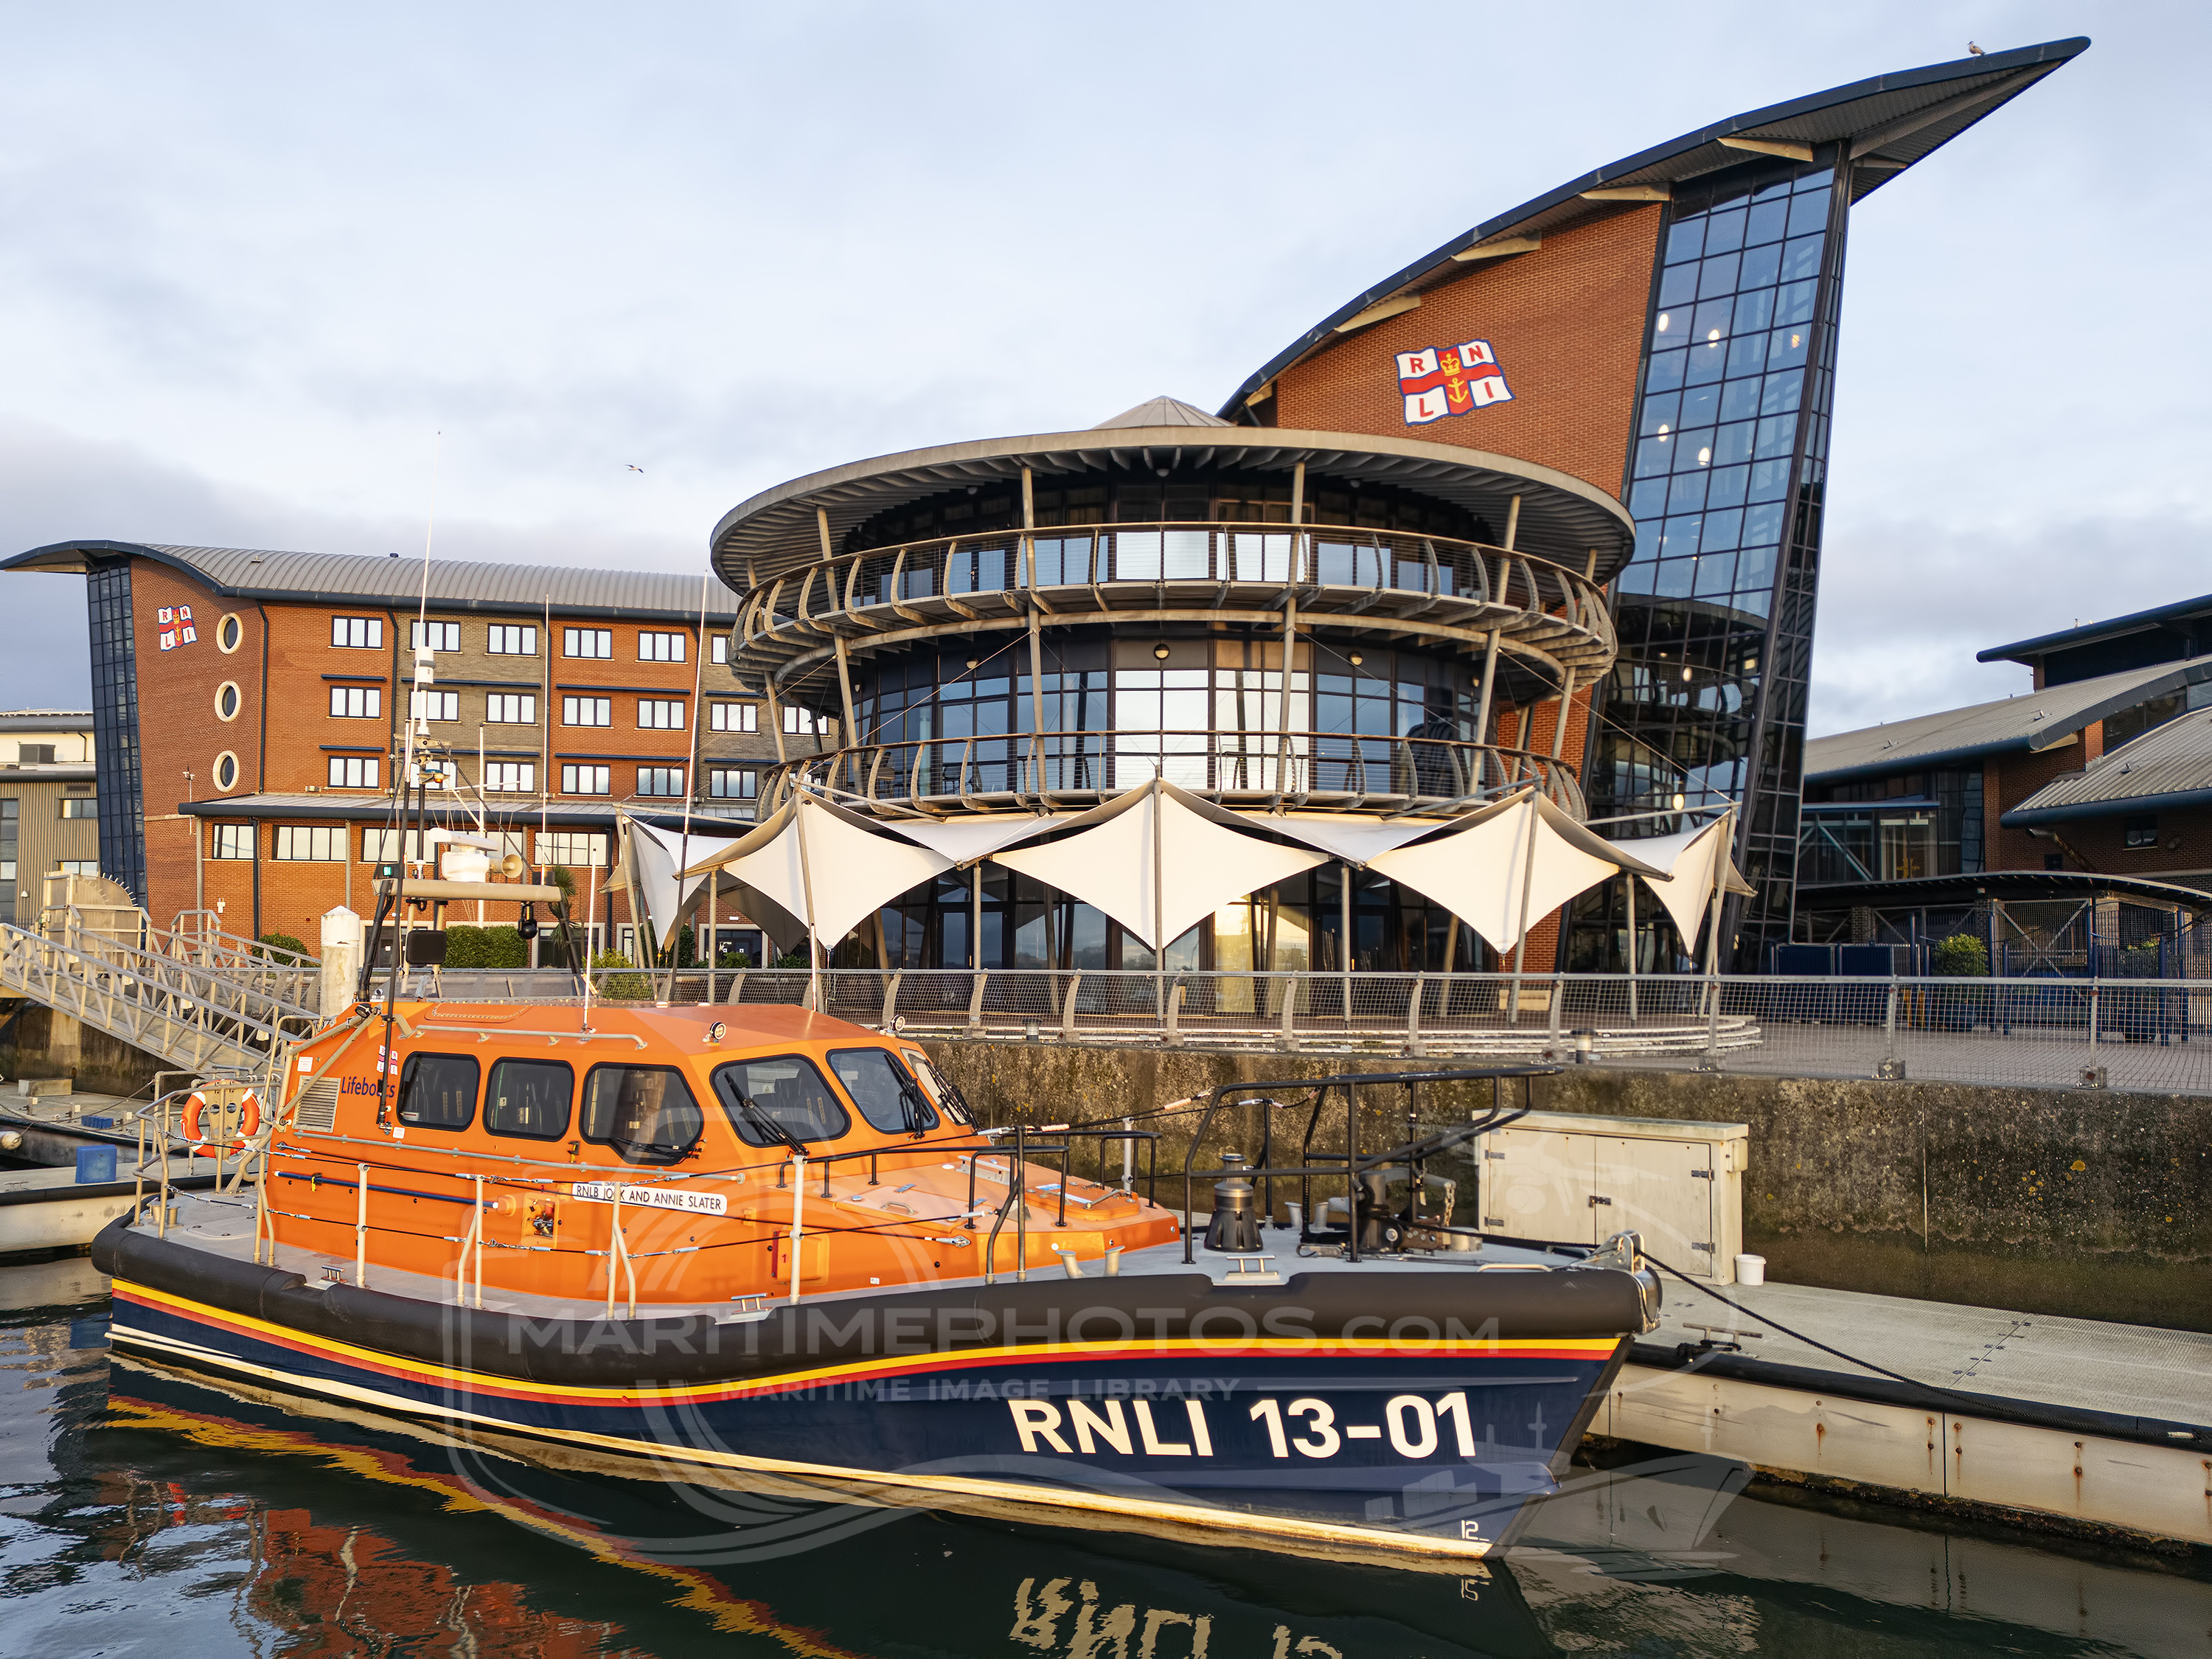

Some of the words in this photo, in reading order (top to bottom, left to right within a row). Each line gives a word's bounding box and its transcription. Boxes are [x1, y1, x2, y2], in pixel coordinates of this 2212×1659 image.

[341, 1076, 396, 1098] Lifebos
[577, 1184, 599, 1198] RNLB
[602, 1183, 625, 1202] JOK
[629, 1190, 650, 1203] AND
[653, 1192, 683, 1206] ANNIE
[688, 1195, 722, 1211] SLATER
[782, 1253, 787, 1263] 1
[1007, 1399, 1214, 1457] RNLI
[1248, 1391, 1476, 1459] 13-01
